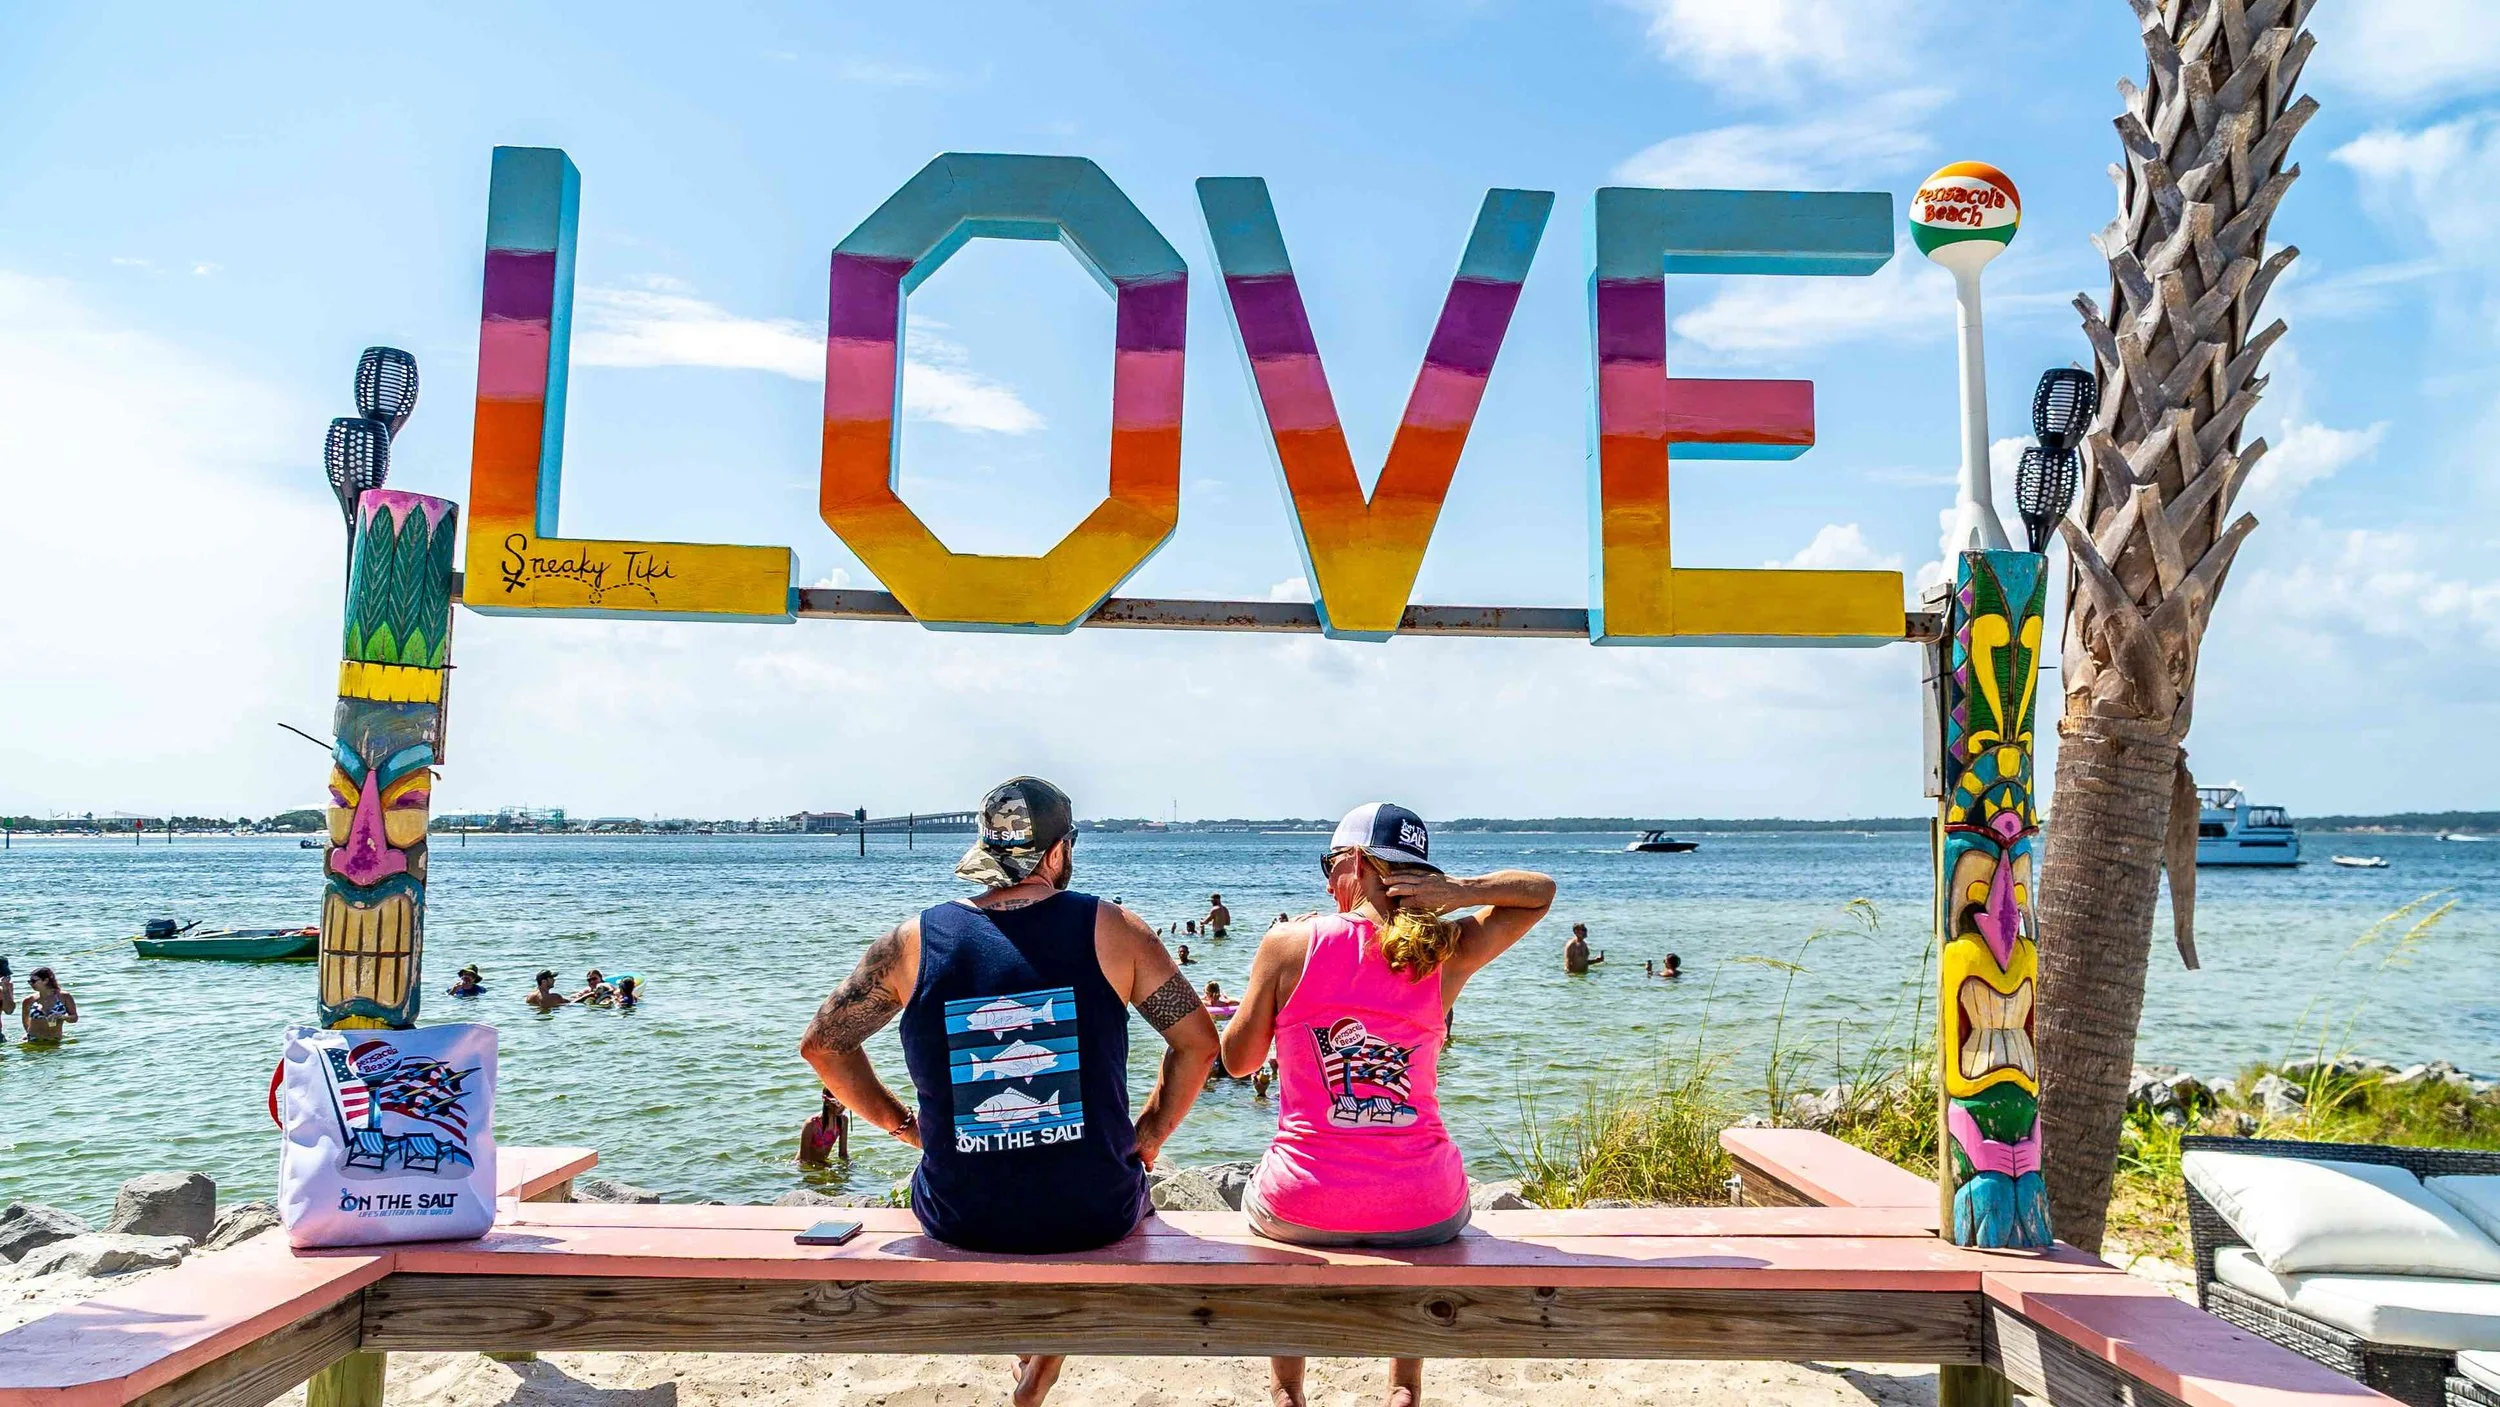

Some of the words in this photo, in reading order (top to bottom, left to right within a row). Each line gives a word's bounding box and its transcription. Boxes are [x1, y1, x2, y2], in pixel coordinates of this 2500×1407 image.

[1915, 187, 2006, 208] Pensacola
[1924, 204, 1983, 227] Beach
[464, 146, 1905, 645] LOVE
[502, 533, 613, 590] Sneaky
[622, 550, 677, 583] Tiki
[1001, 830, 1025, 841] SALT
[1399, 829, 1426, 850] SALT
[1340, 1033, 1361, 1046] Beach
[363, 1058, 395, 1073] Beach
[956, 1132, 989, 1153] ON
[994, 1130, 1035, 1150] THE
[1041, 1122, 1085, 1144] SALT
[340, 1194, 372, 1211] ON
[376, 1194, 412, 1210] THE
[418, 1193, 458, 1208] SALT
